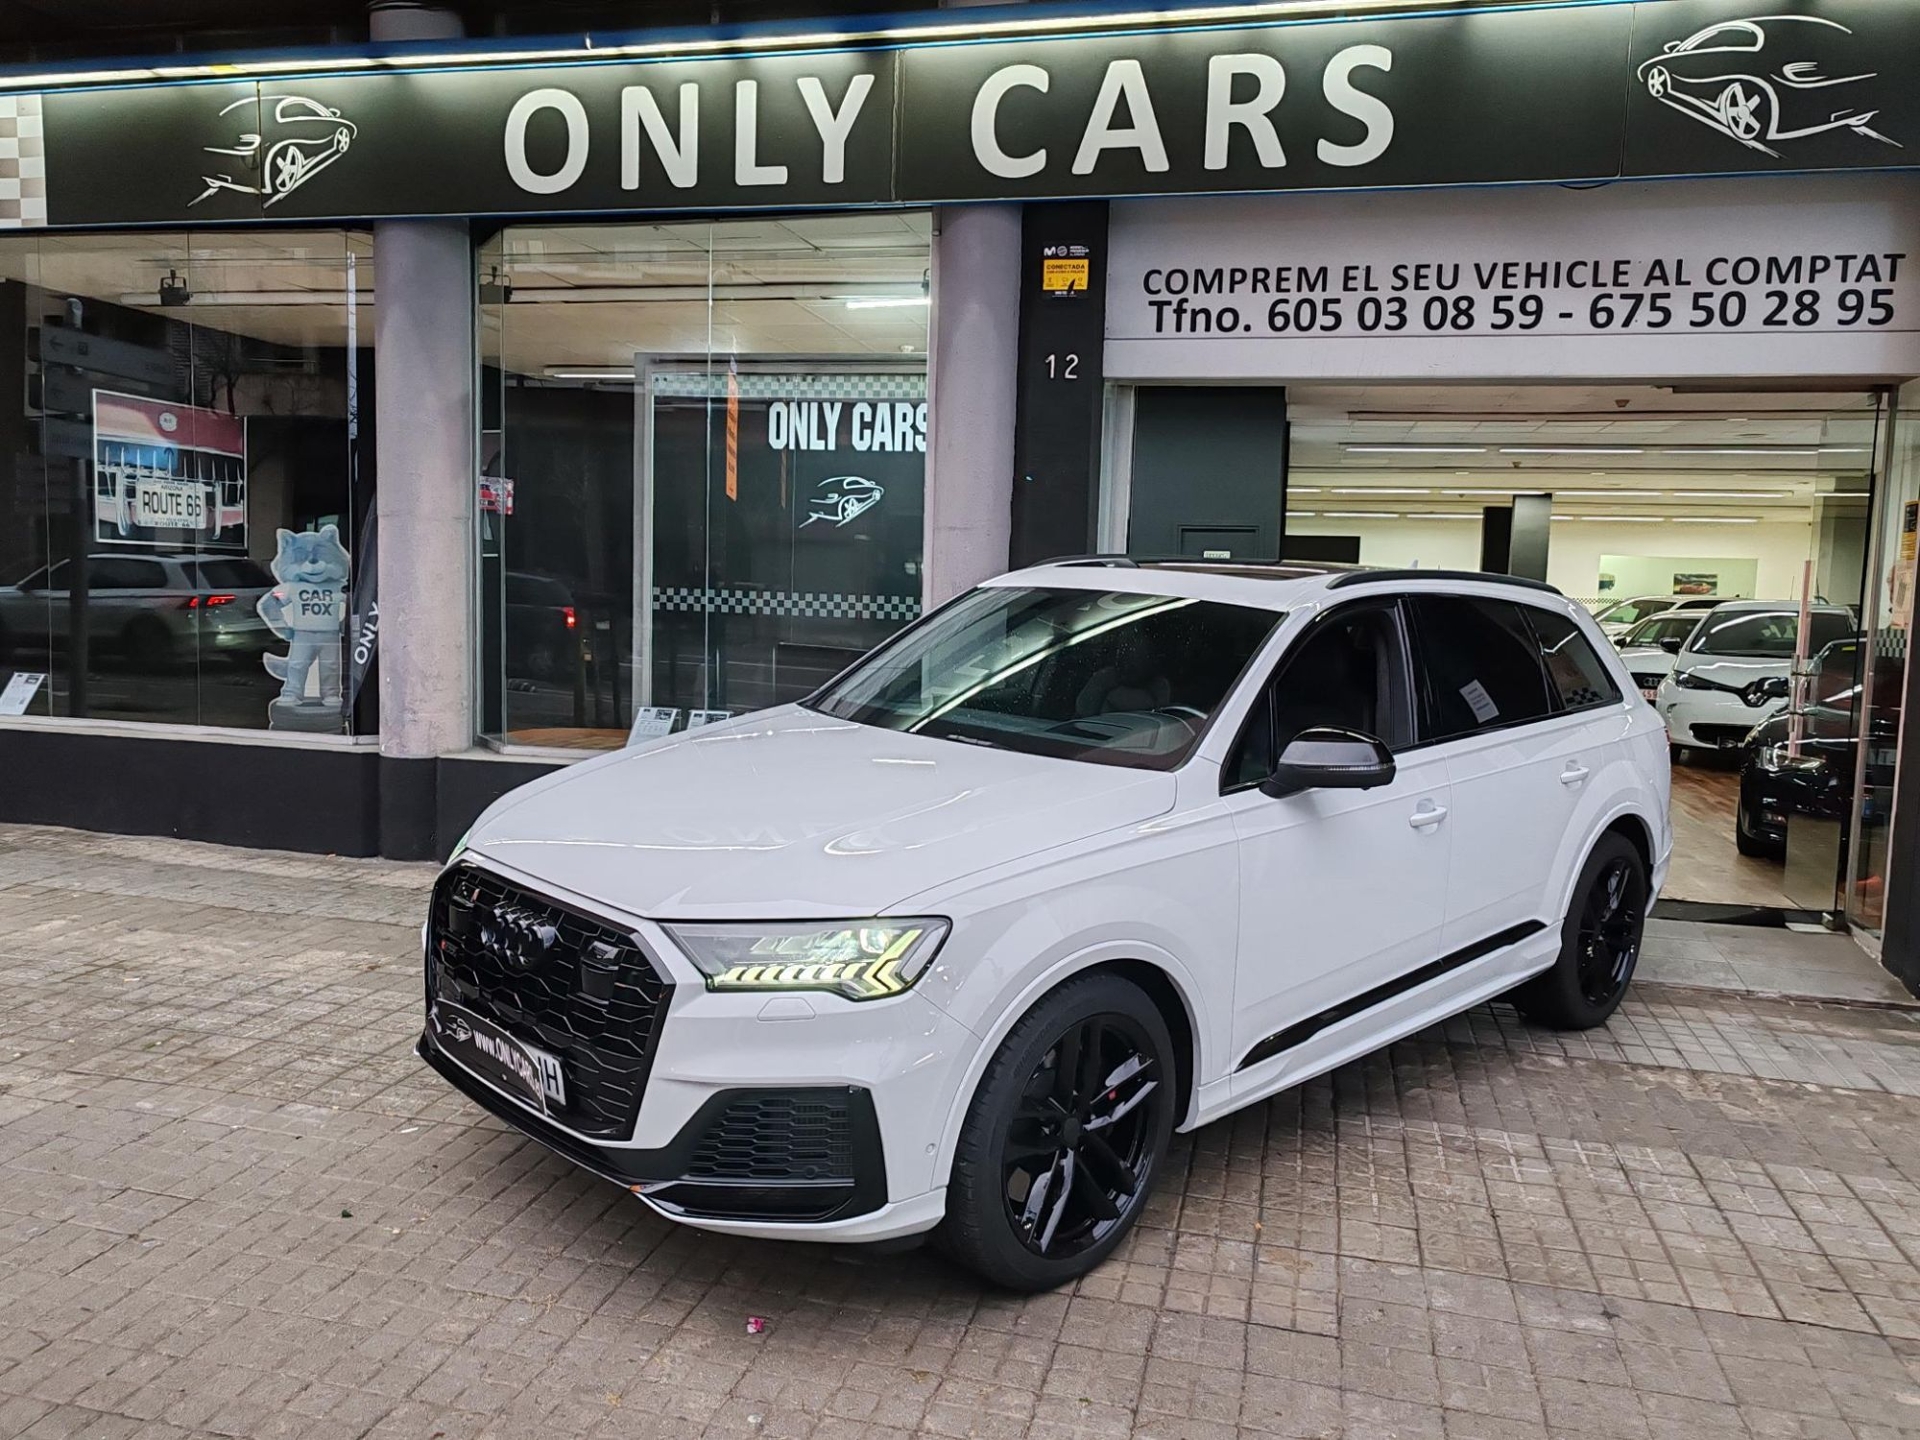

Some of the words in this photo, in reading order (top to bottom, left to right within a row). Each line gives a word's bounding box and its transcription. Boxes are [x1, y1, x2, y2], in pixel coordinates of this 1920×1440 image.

[504, 74, 875, 195] ONLY
[970, 44, 1395, 179] CARS
[1143, 266, 1328, 294] COMPREM
[1342, 265, 1379, 292] EL
[1390, 263, 1460, 291] SEU
[1474, 259, 1632, 290] VEHICLE
[1643, 258, 1692, 287] AL
[1705, 253, 1906, 285] COMPTAT
[1148, 299, 1251, 333] Tfno.
[1268, 299, 1342, 332] 605
[1357, 297, 1408, 332] 03
[1423, 295, 1475, 331] 08
[1490, 294, 1544, 330] 59
[1589, 293, 1672, 329] 675
[1689, 291, 1746, 328] 50
[1762, 289, 1820, 327] 28
[1836, 288, 1895, 326] 95
[1045, 354, 1079, 379] 12
[768, 401, 842, 451] ONLY
[851, 402, 928, 453] CARS
[143, 491, 182, 516] ROUTE
[186, 494, 202, 517] 66
[299, 589, 333, 602] CAR
[301, 602, 332, 616] FOX
[354, 601, 379, 664] ONLY
